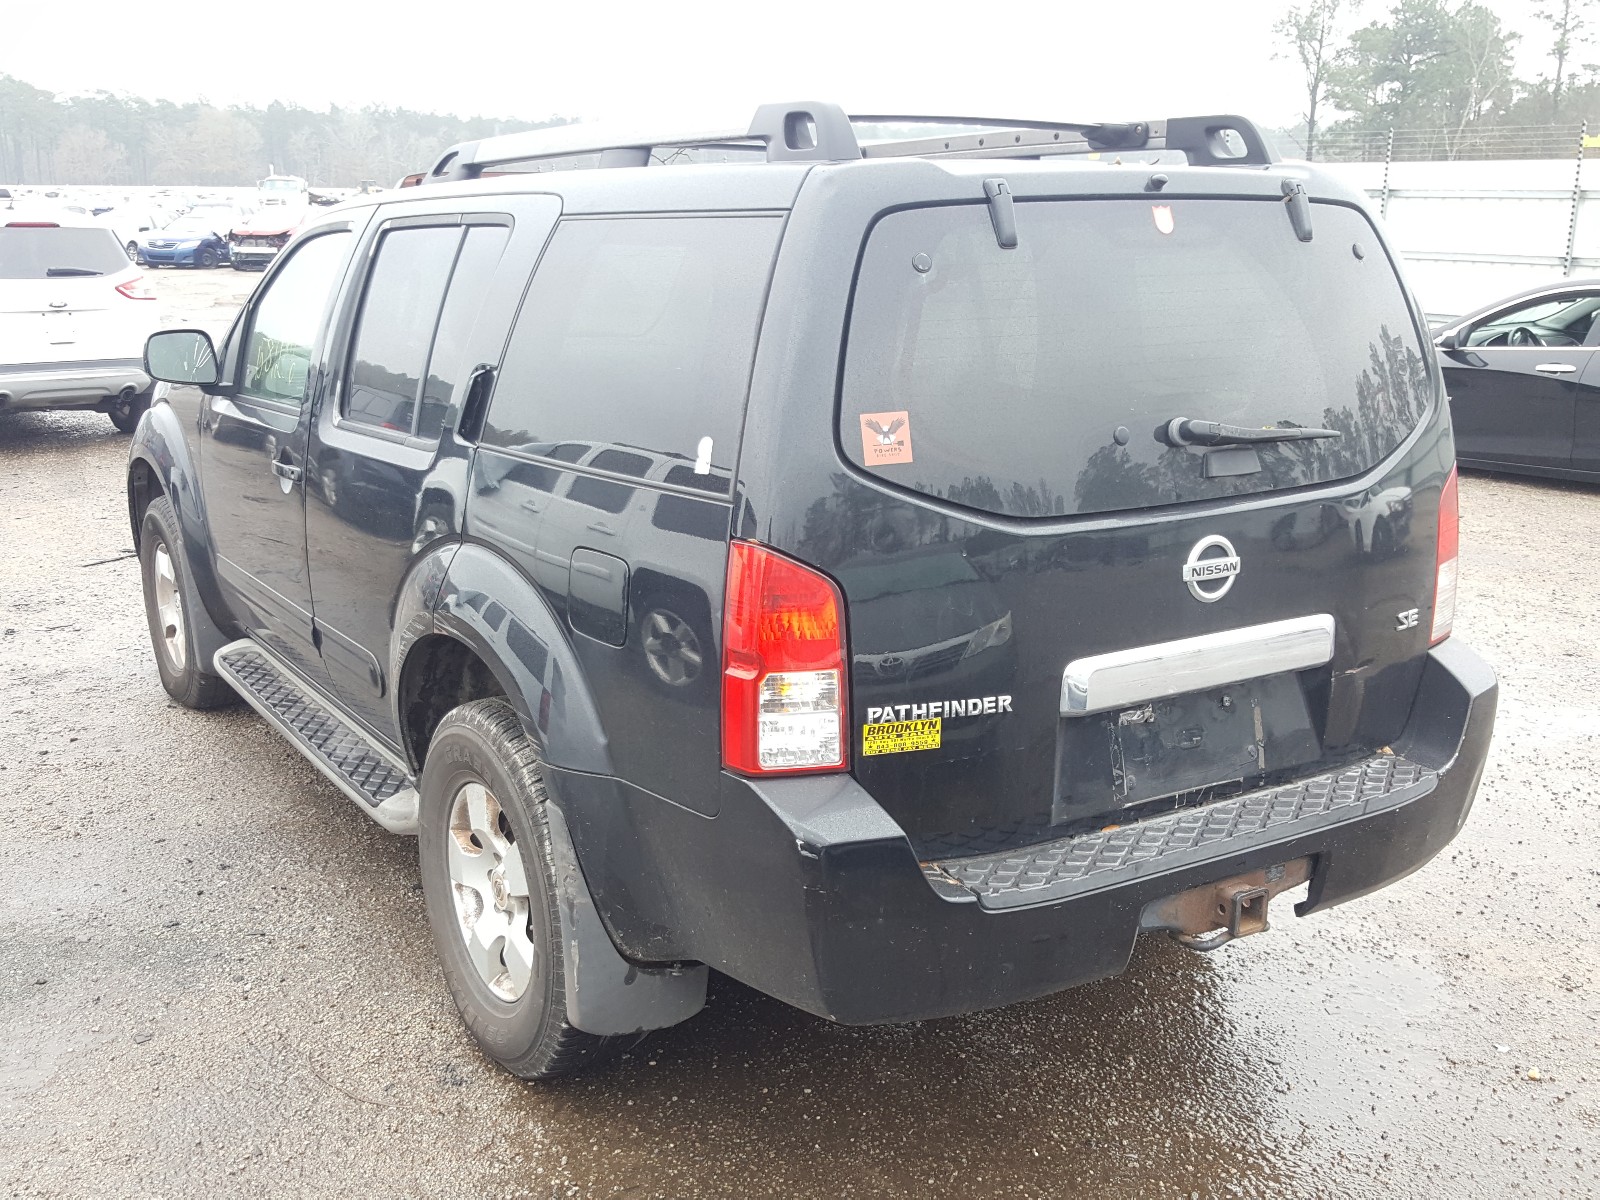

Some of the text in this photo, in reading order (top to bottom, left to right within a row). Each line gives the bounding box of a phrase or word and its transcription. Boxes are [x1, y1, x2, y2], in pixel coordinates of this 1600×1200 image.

[1191, 562, 1237, 578] NISSAN
[1395, 608, 1419, 632] SE
[867, 695, 1013, 724] PATHFINDER
[867, 720, 938, 736] BROOKLYN
